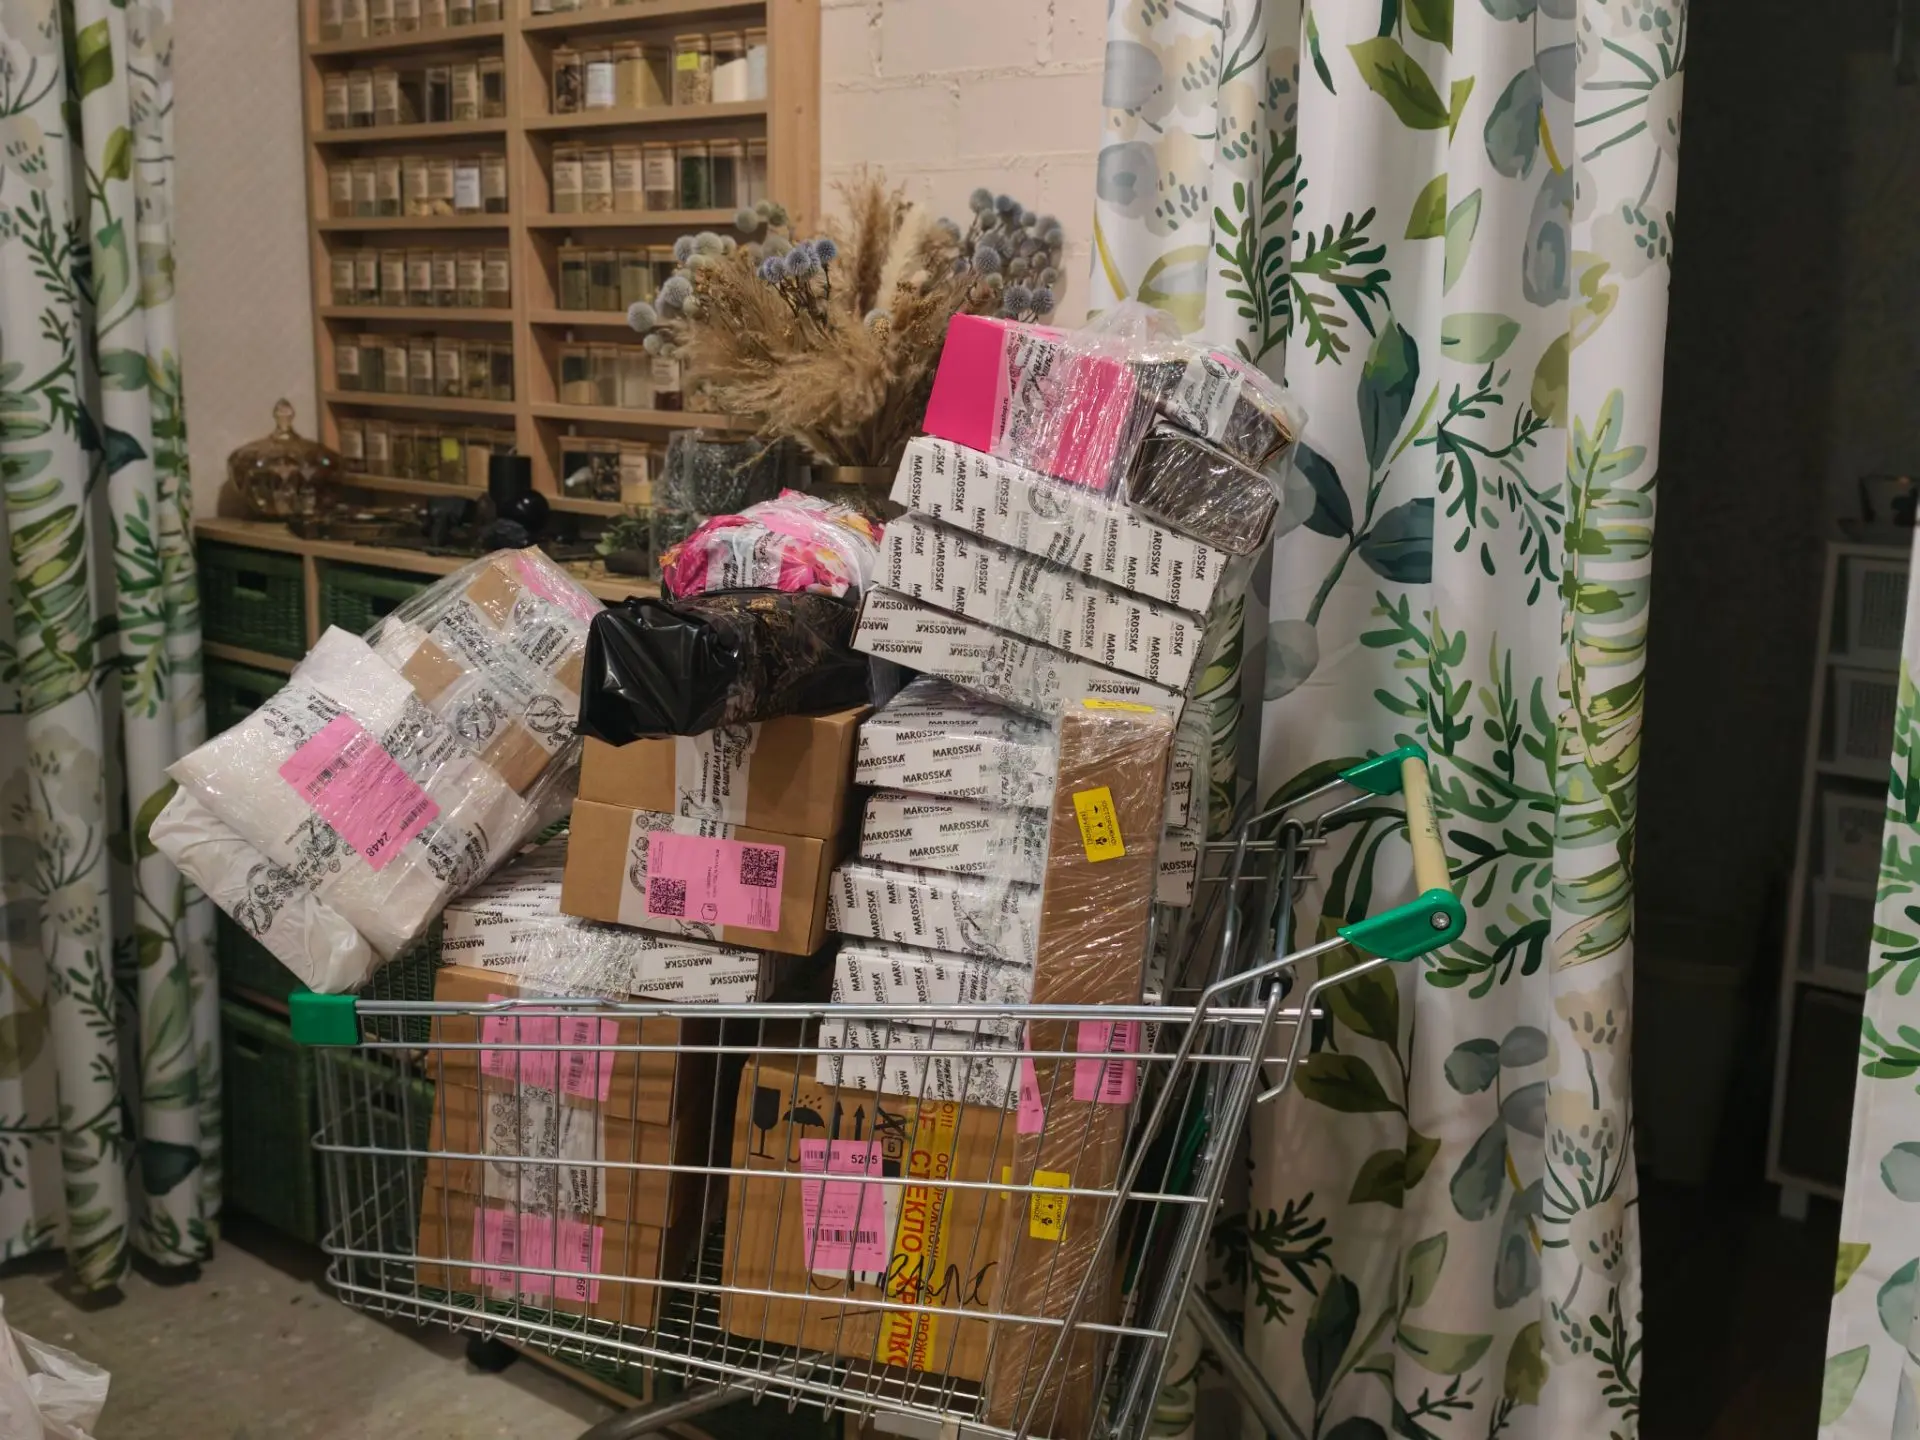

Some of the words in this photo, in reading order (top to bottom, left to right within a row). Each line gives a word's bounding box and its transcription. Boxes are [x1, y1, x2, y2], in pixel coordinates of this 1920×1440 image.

[911, 454, 923, 510] MAROSSKA
[1105, 518, 1118, 572] MAROSSKA
[1150, 530, 1162, 577] AROSSKA
[892, 536, 902, 589] MAROSSKA
[978, 554, 988, 596] ROSSKA
[1127, 556, 1138, 592] MAROS
[1196, 546, 1208, 581] OSSKA
[955, 586, 966, 614] MARO
[857, 620, 888, 631] MAROS
[916, 624, 966, 635] MAROSSKA
[1084, 596, 1096, 650] MAROSSKA
[1128, 608, 1140, 653] AROSSKA
[872, 642, 922, 654] MAROSSKA
[1105, 633, 1116, 668] MAROS
[1174, 624, 1184, 656] OSSKA
[1087, 683, 1140, 695] MAROSSKA
[896, 730, 946, 741] MAROSSKA
[932, 744, 982, 757] MAROSSKA
[902, 769, 952, 783] MAROSSKA
[863, 828, 912, 841] MAROSSKA
[939, 819, 989, 833] MAROSSKA
[366, 832, 392, 856] 2448
[909, 844, 960, 857] MAROSSKA
[843, 872, 856, 908] MAROSS
[908, 886, 922, 935] MAROSSKA
[665, 957, 712, 969] MAROSSKA
[848, 956, 861, 991] MAROSS
[891, 960, 903, 986] MARO
[710, 974, 758, 986] MAROSSKA
[871, 972, 883, 1002] OSSKA
[914, 967, 927, 1002] ROSSKA
[899, 1070, 910, 1096] MARO
[902, 1150, 932, 1253] СТЕКЛО
